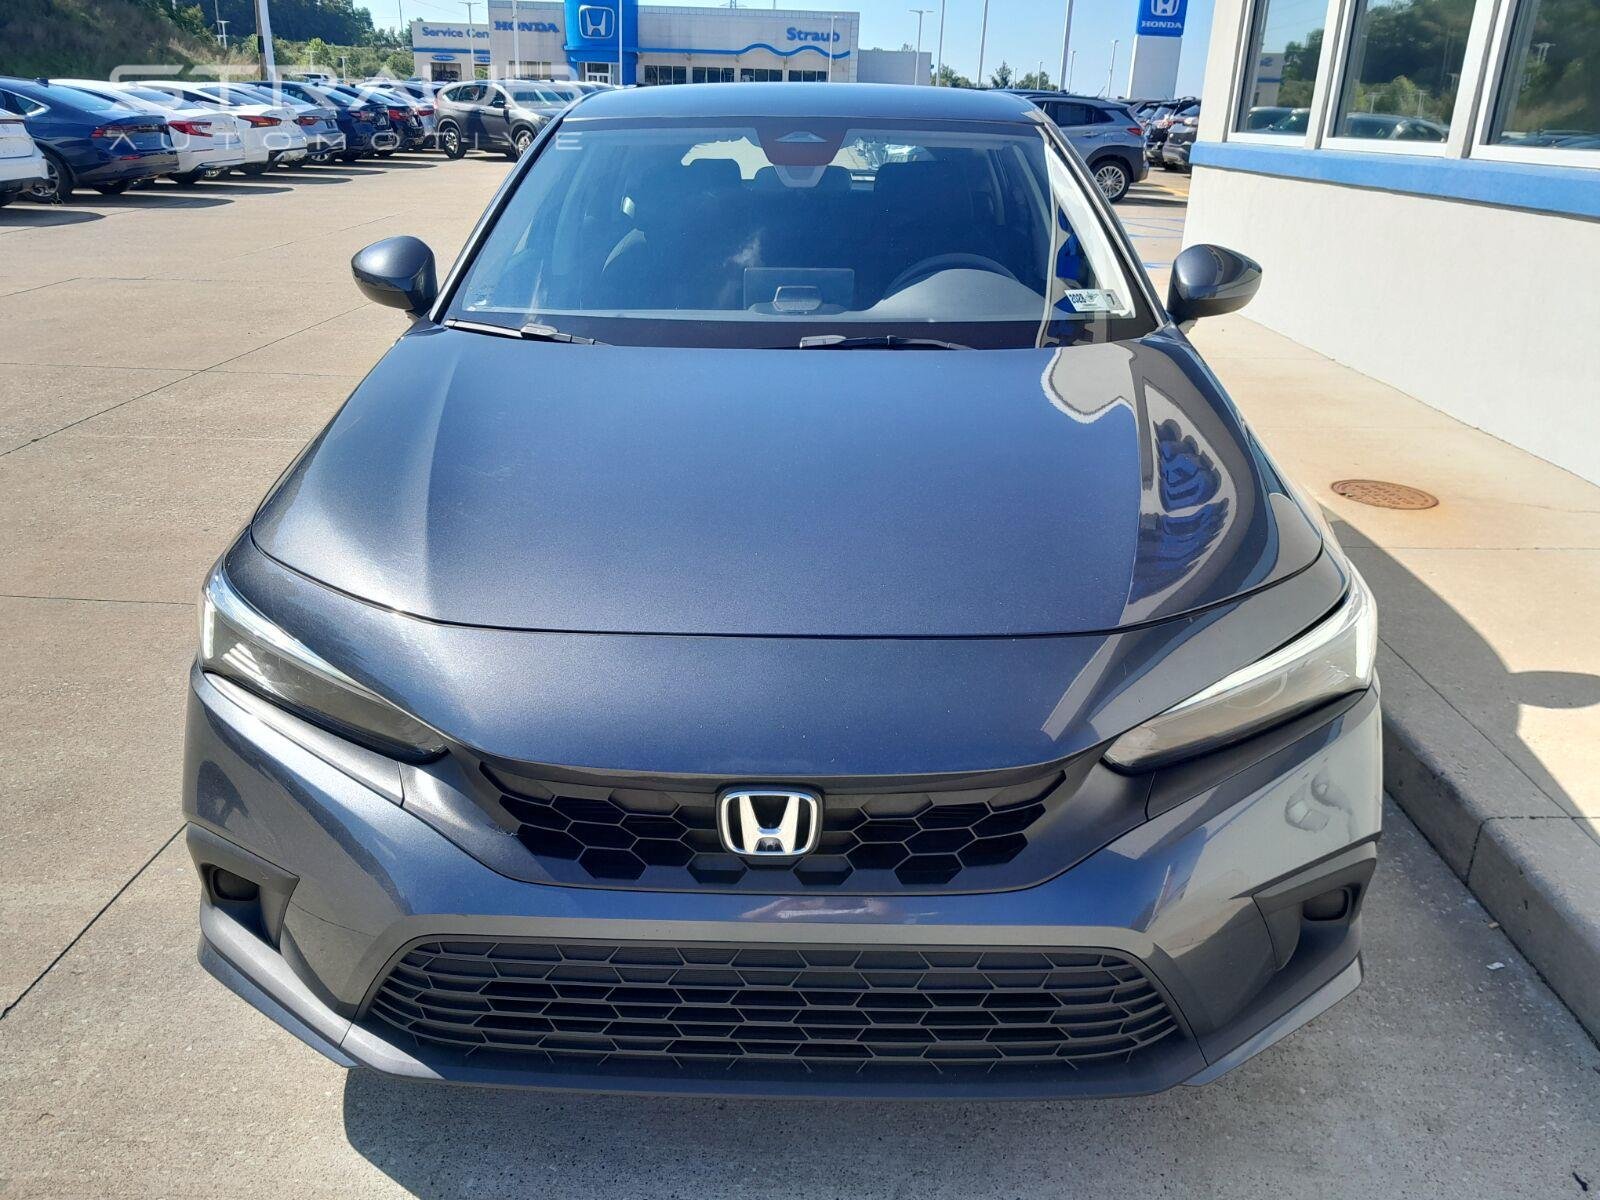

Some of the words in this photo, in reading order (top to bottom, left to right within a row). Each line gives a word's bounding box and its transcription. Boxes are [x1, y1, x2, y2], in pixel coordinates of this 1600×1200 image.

[494, 20, 560, 33] HONDA
[1141, 20, 1182, 29] HONDA
[422, 26, 463, 38] Service
[786, 27, 840, 42] Straub
